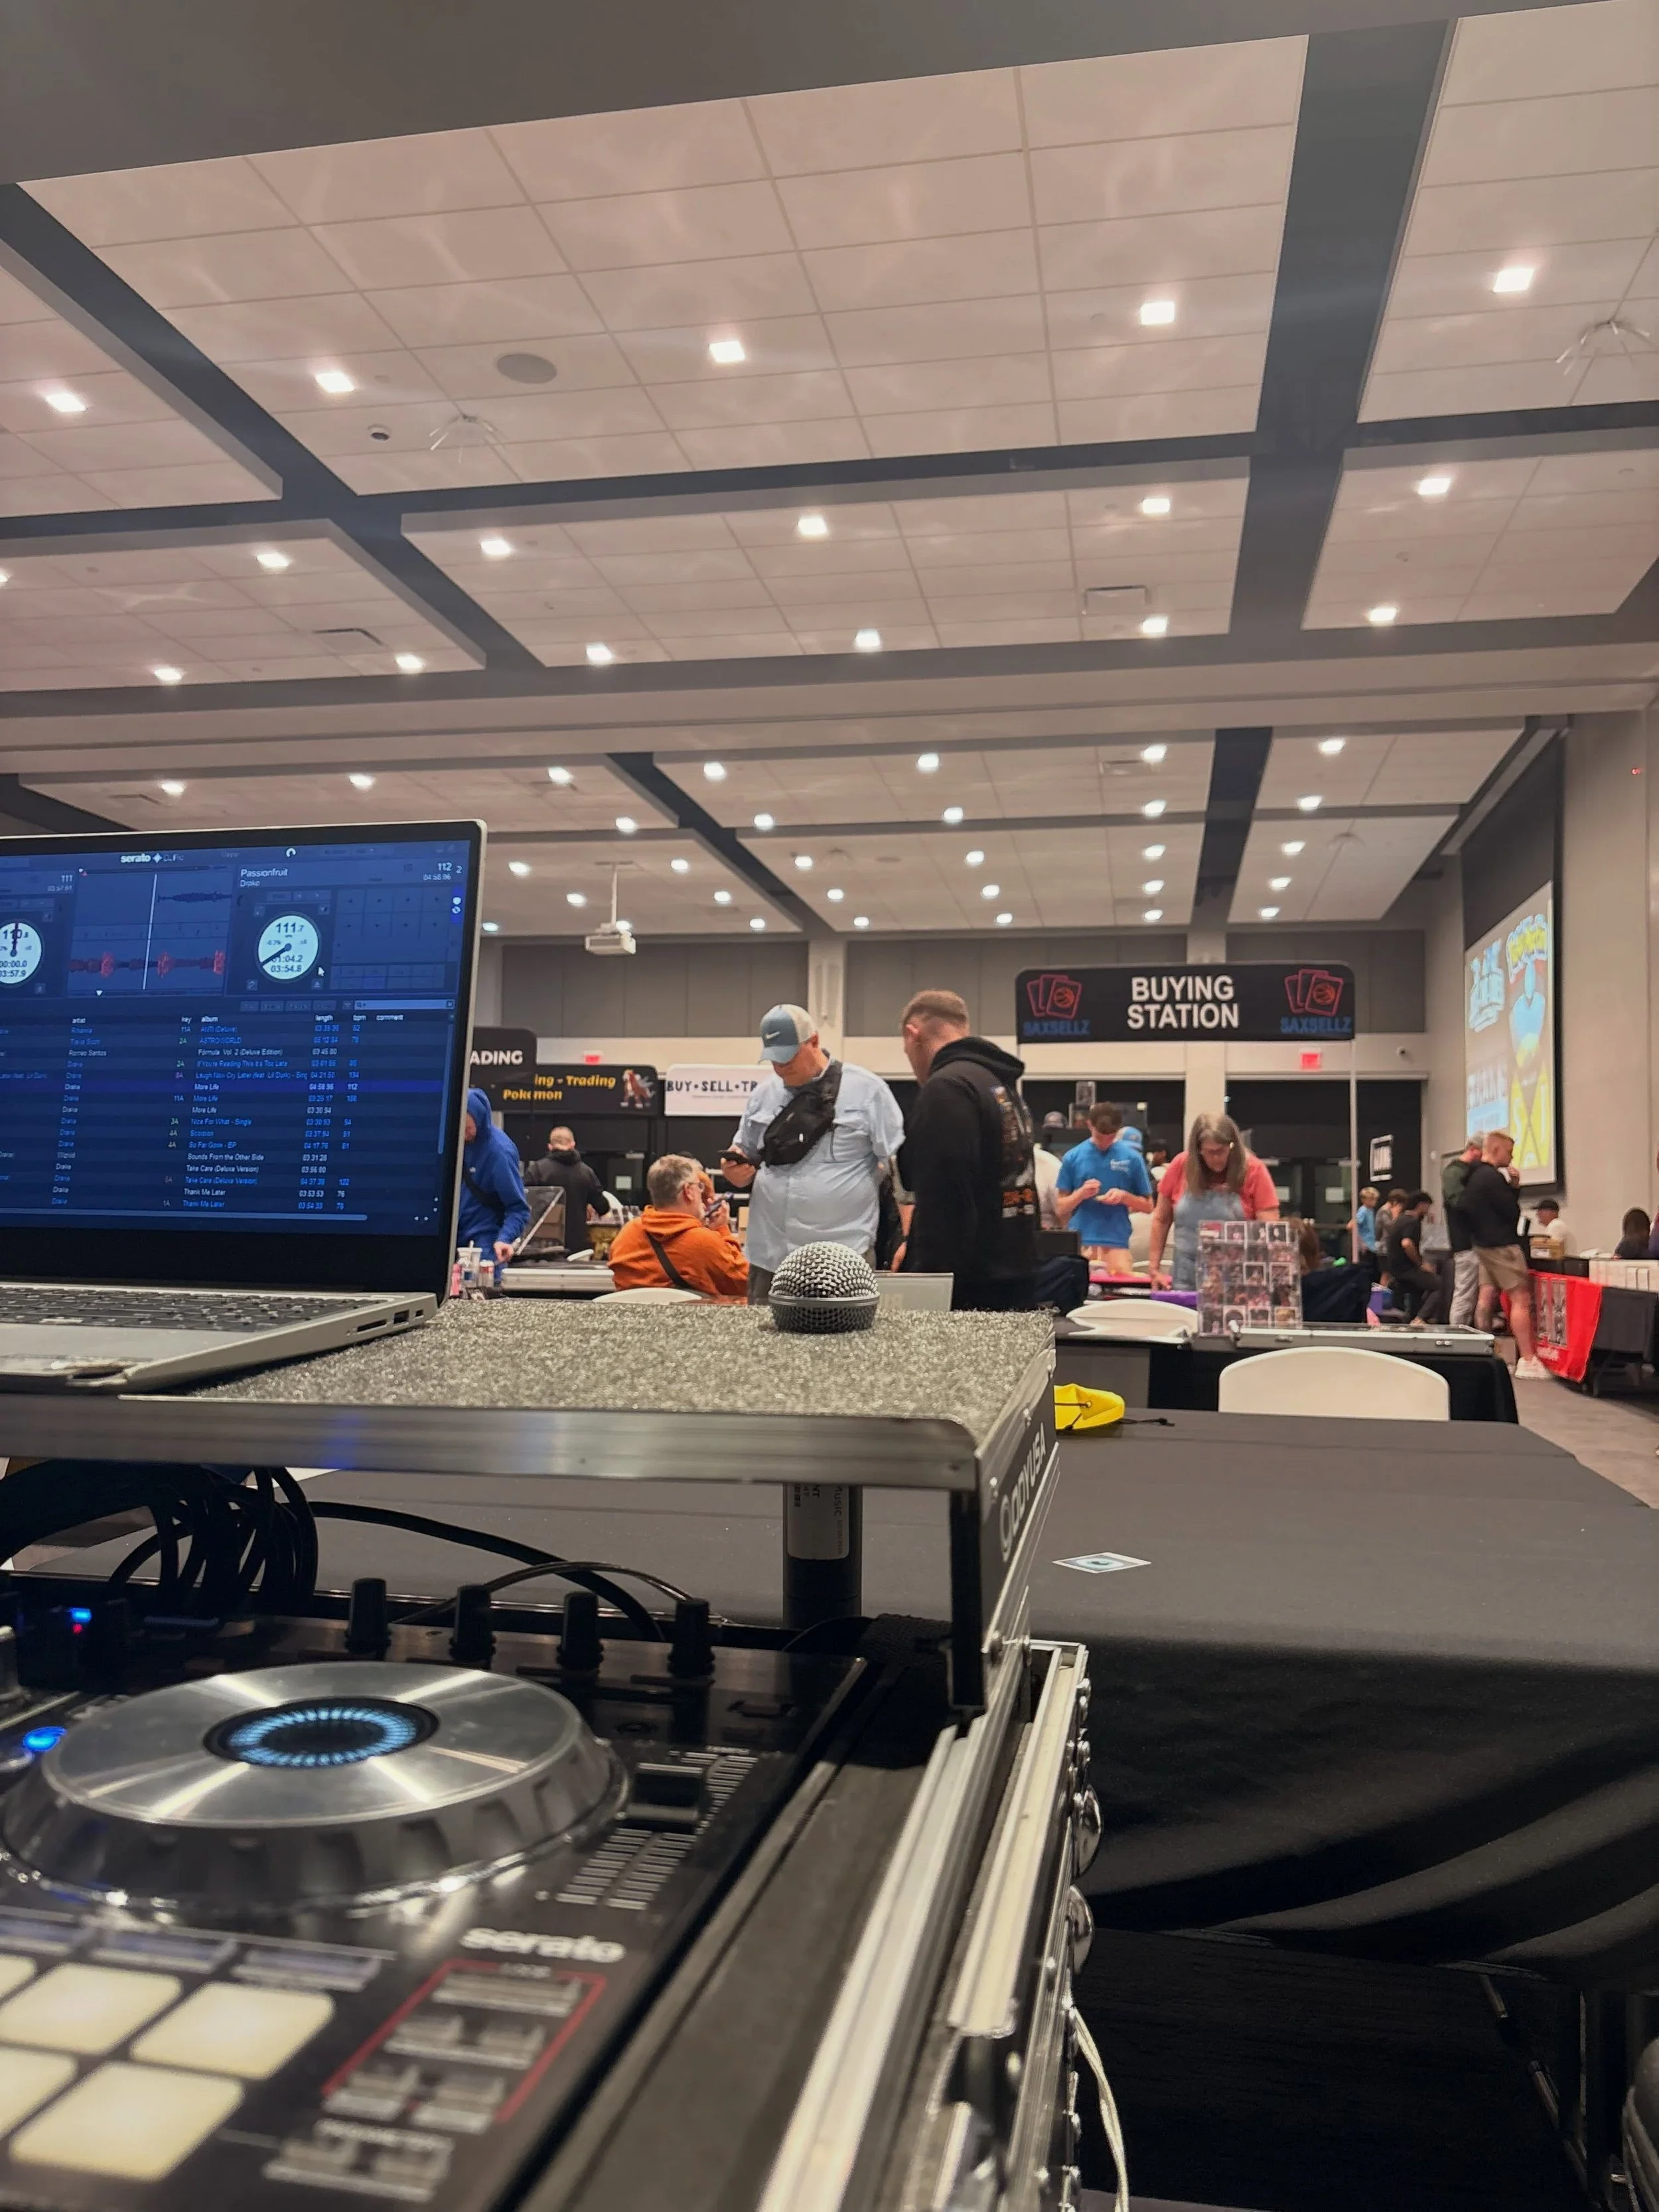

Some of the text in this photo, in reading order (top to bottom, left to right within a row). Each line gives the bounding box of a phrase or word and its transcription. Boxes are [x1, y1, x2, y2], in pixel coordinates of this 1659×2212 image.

[120, 853, 151, 863] serato
[437, 861, 453, 871] 112
[455, 864, 463, 874] 2
[240, 868, 289, 877] Passionfruit
[1131, 976, 1234, 1001] BUYING
[1127, 1003, 1240, 1030] STATION
[565, 1074, 616, 1089] Trading
[460, 1927, 626, 1963] serato
